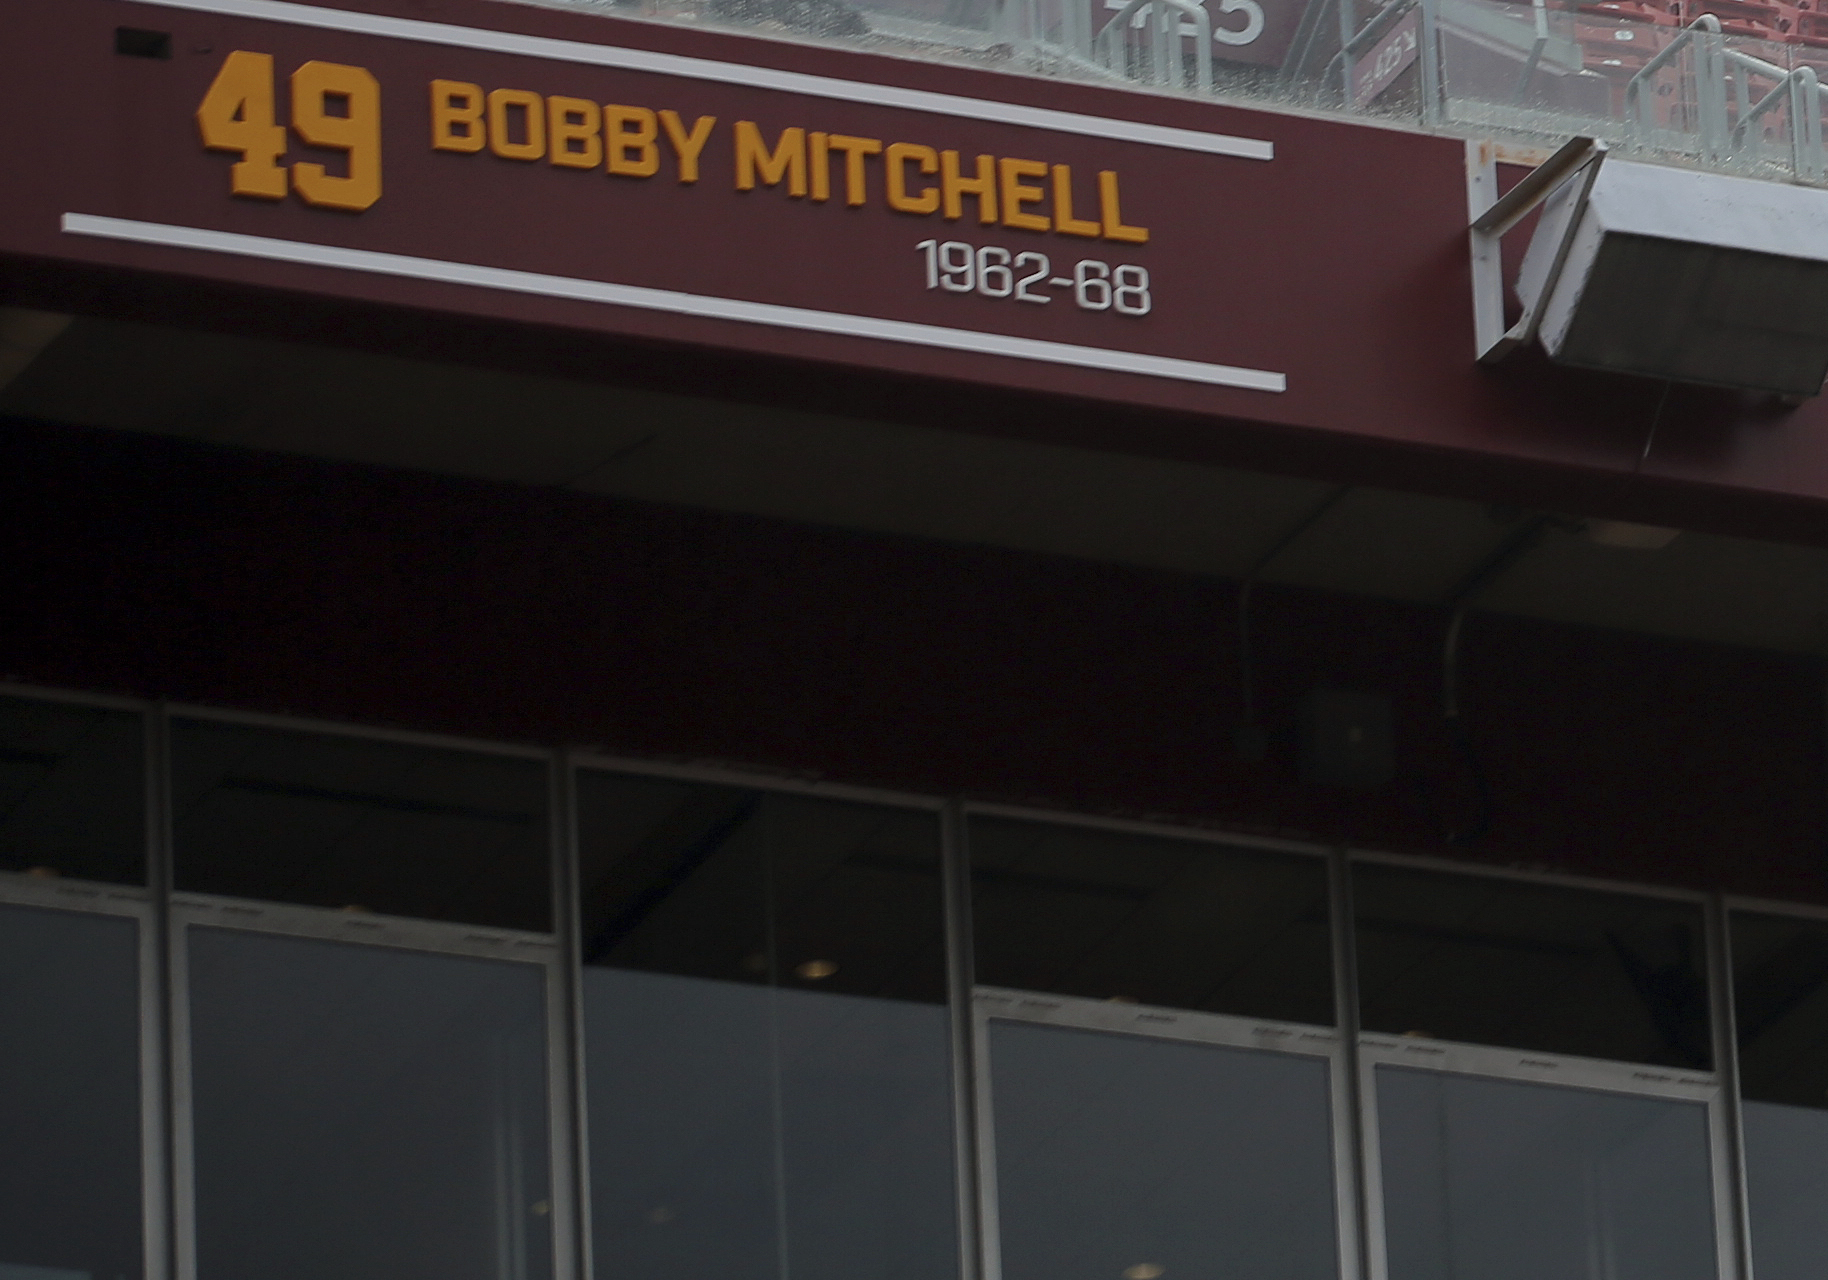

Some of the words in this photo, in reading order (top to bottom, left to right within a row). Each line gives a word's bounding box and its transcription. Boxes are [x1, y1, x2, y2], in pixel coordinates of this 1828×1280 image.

[194, 49, 385, 212] 49
[429, 77, 718, 183] BOBBY
[733, 118, 1152, 244] MITCHELL
[914, 238, 1152, 316] 1962-68
